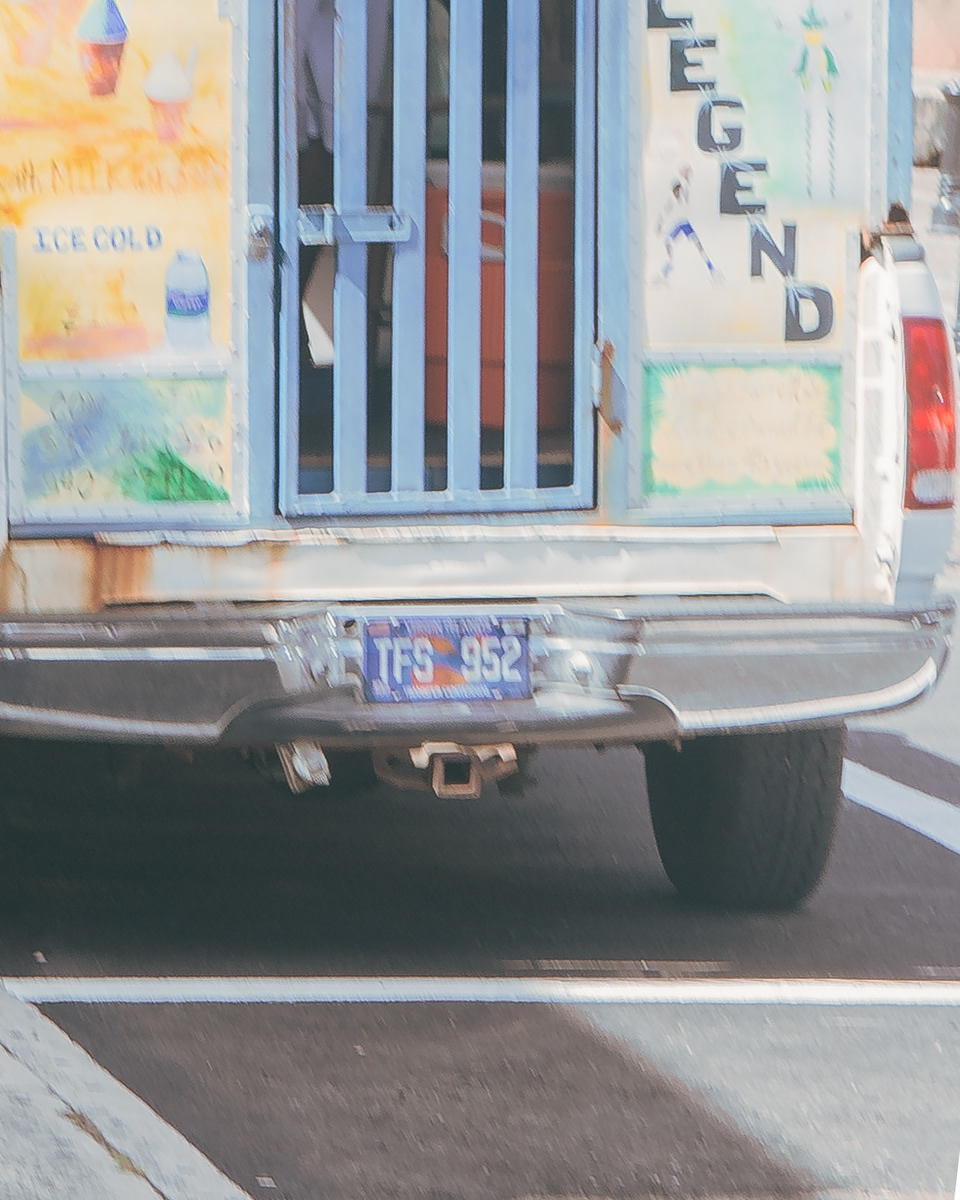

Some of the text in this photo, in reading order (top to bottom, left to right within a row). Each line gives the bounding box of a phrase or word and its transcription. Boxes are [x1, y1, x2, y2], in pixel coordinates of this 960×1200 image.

[33, 224, 163, 254] ICE COLD
[460, 635, 522, 684] 952
